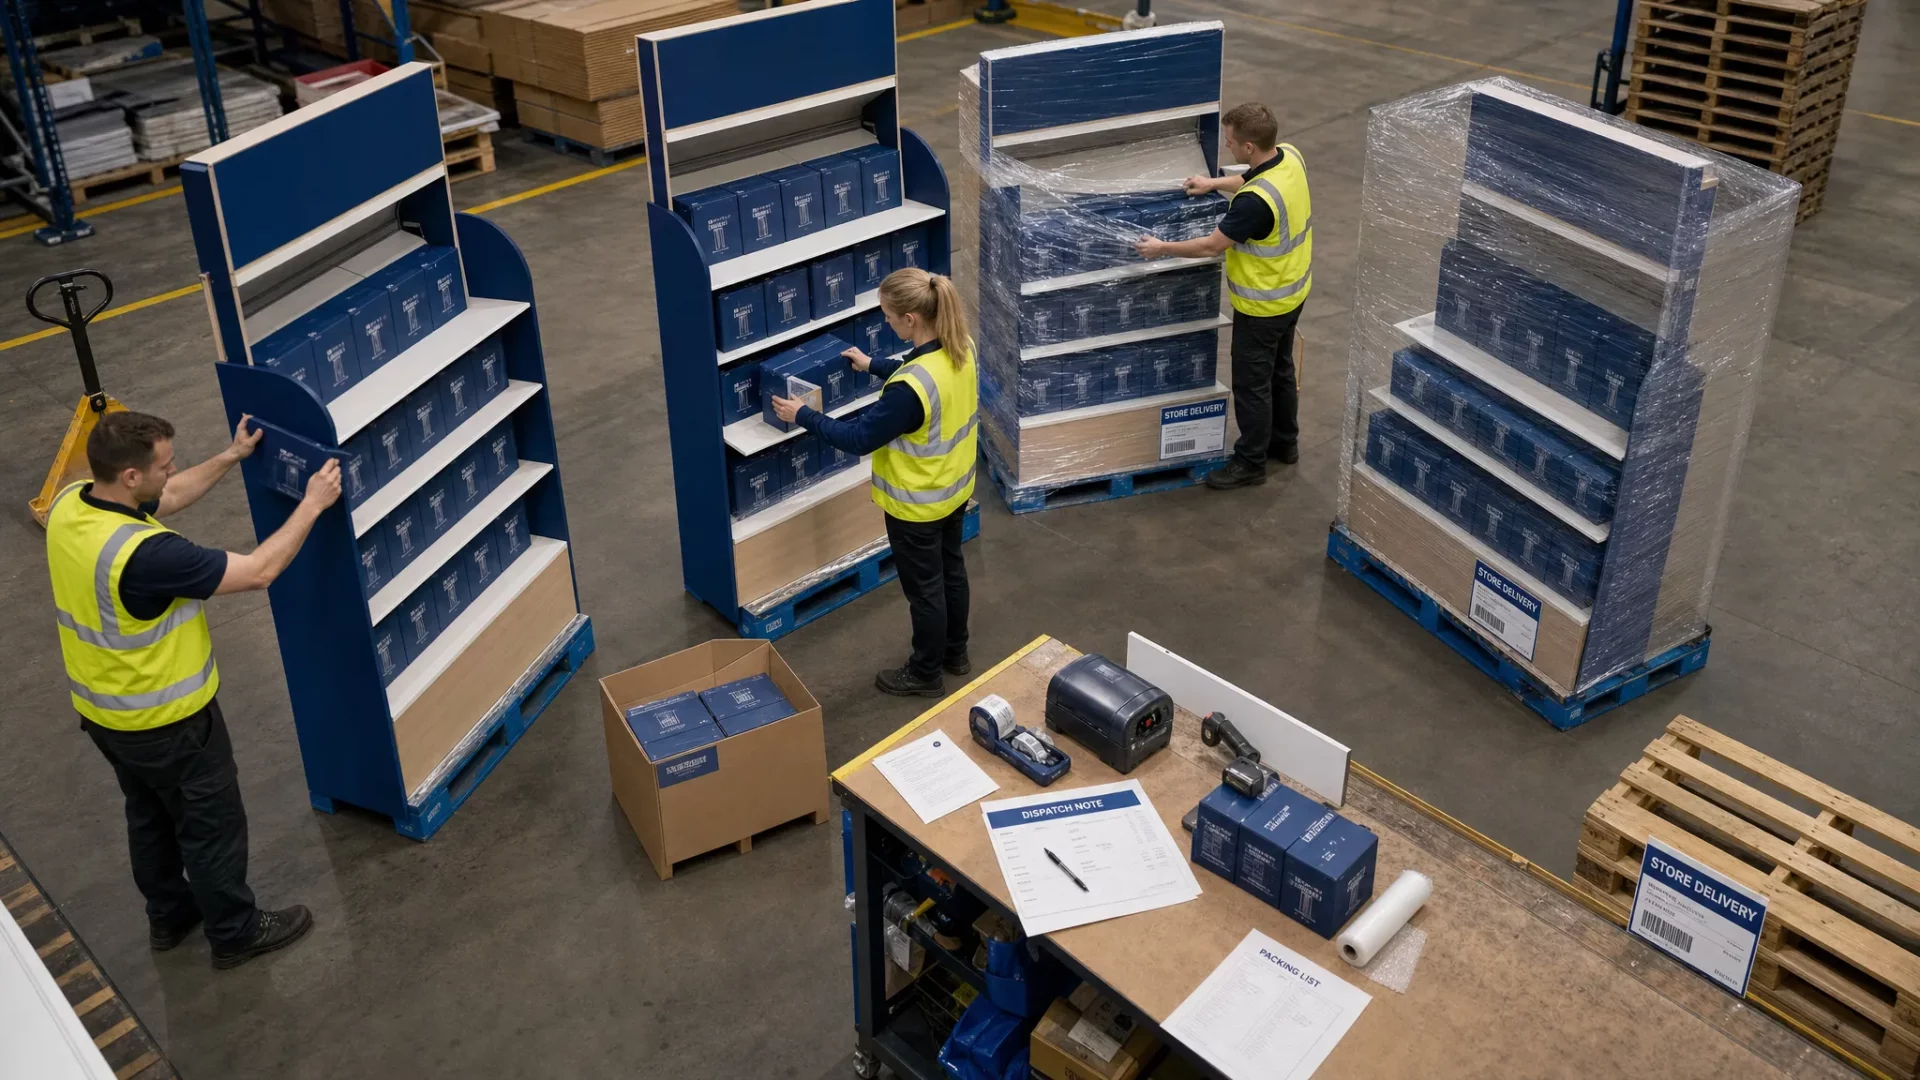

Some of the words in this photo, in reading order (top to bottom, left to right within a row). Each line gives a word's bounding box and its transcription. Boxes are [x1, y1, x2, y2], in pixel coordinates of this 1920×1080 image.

[1164, 408, 1189, 420] STORE
[1190, 403, 1225, 416] DELIVERY
[1477, 567, 1502, 590] STORE
[1502, 584, 1538, 613] DELIVERY
[1021, 801, 1074, 820] DISPATCH
[1074, 799, 1104, 812] NOTE
[1650, 856, 1693, 888] STORE
[1694, 879, 1758, 922] DELIVERY
[1259, 948, 1300, 976] PACKING
[1299, 972, 1322, 989] LIST
